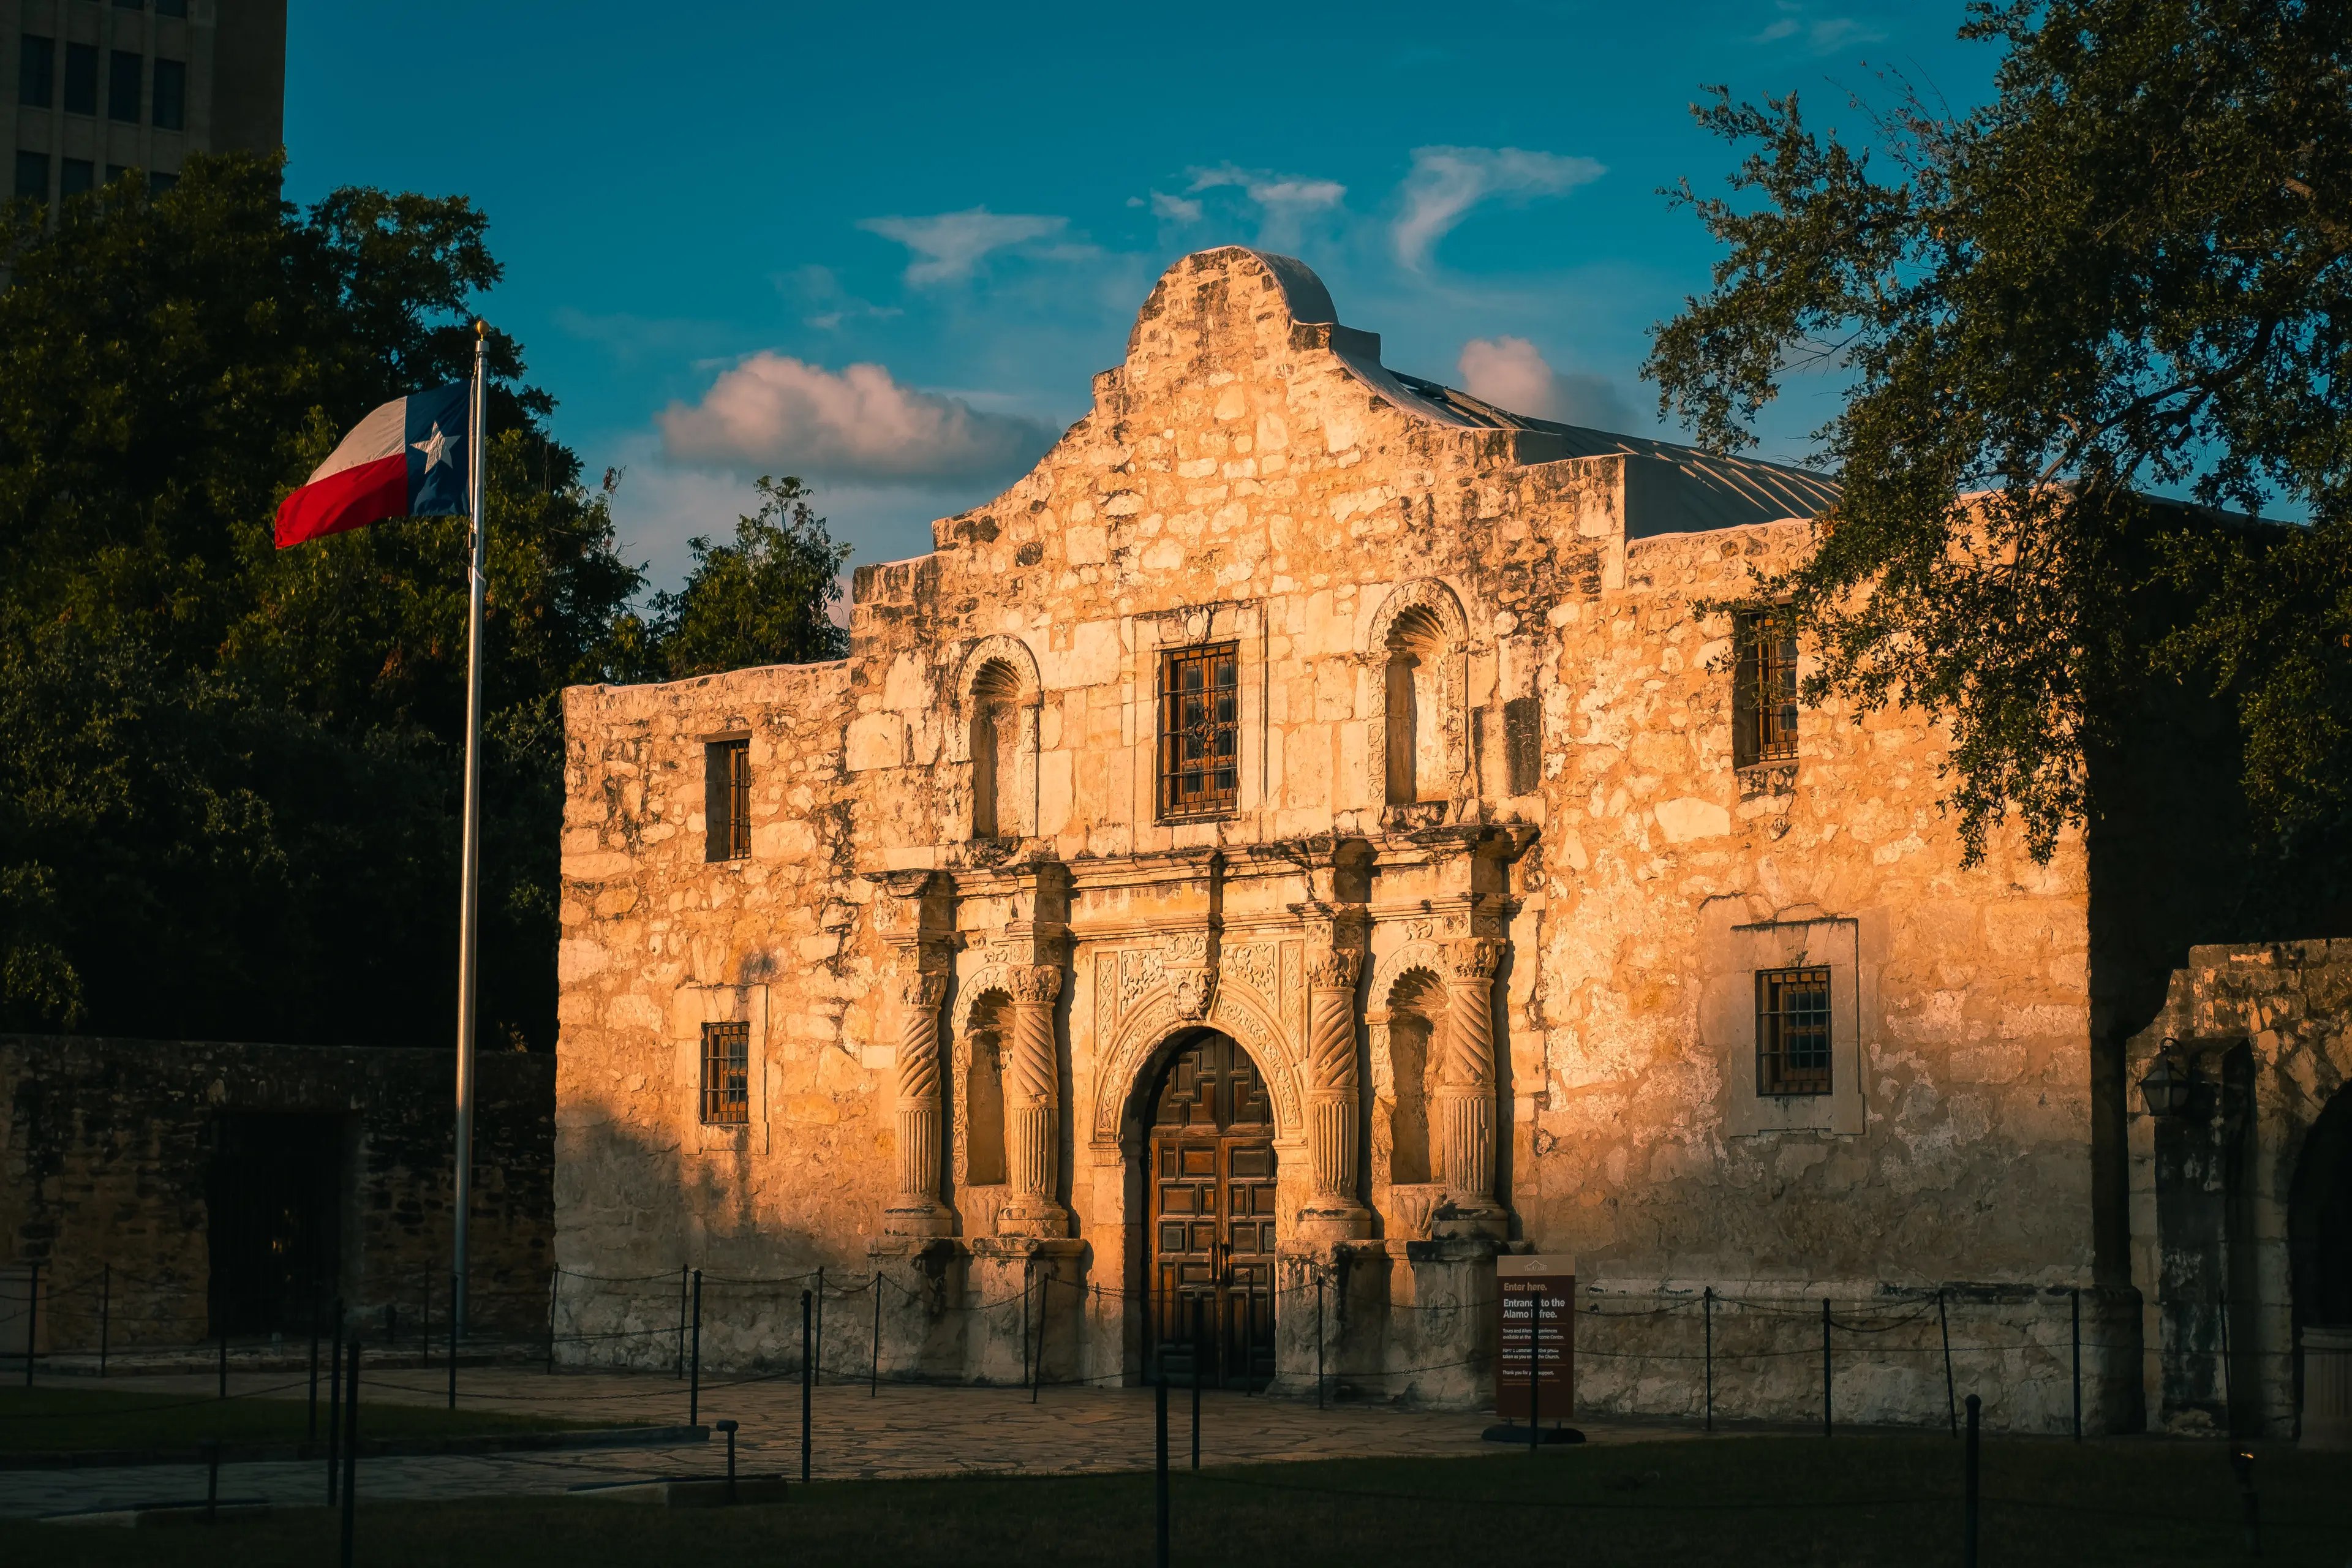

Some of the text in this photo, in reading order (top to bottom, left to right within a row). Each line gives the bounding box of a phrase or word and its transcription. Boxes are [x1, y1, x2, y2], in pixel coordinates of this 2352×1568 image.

[1504, 1281, 1547, 1291] Enter here.
[1504, 1298, 1532, 1307] Entranc
[1551, 1297, 1565, 1307] the
[1503, 1310, 1529, 1318] Alamo
[1539, 1309, 1558, 1318] free.
